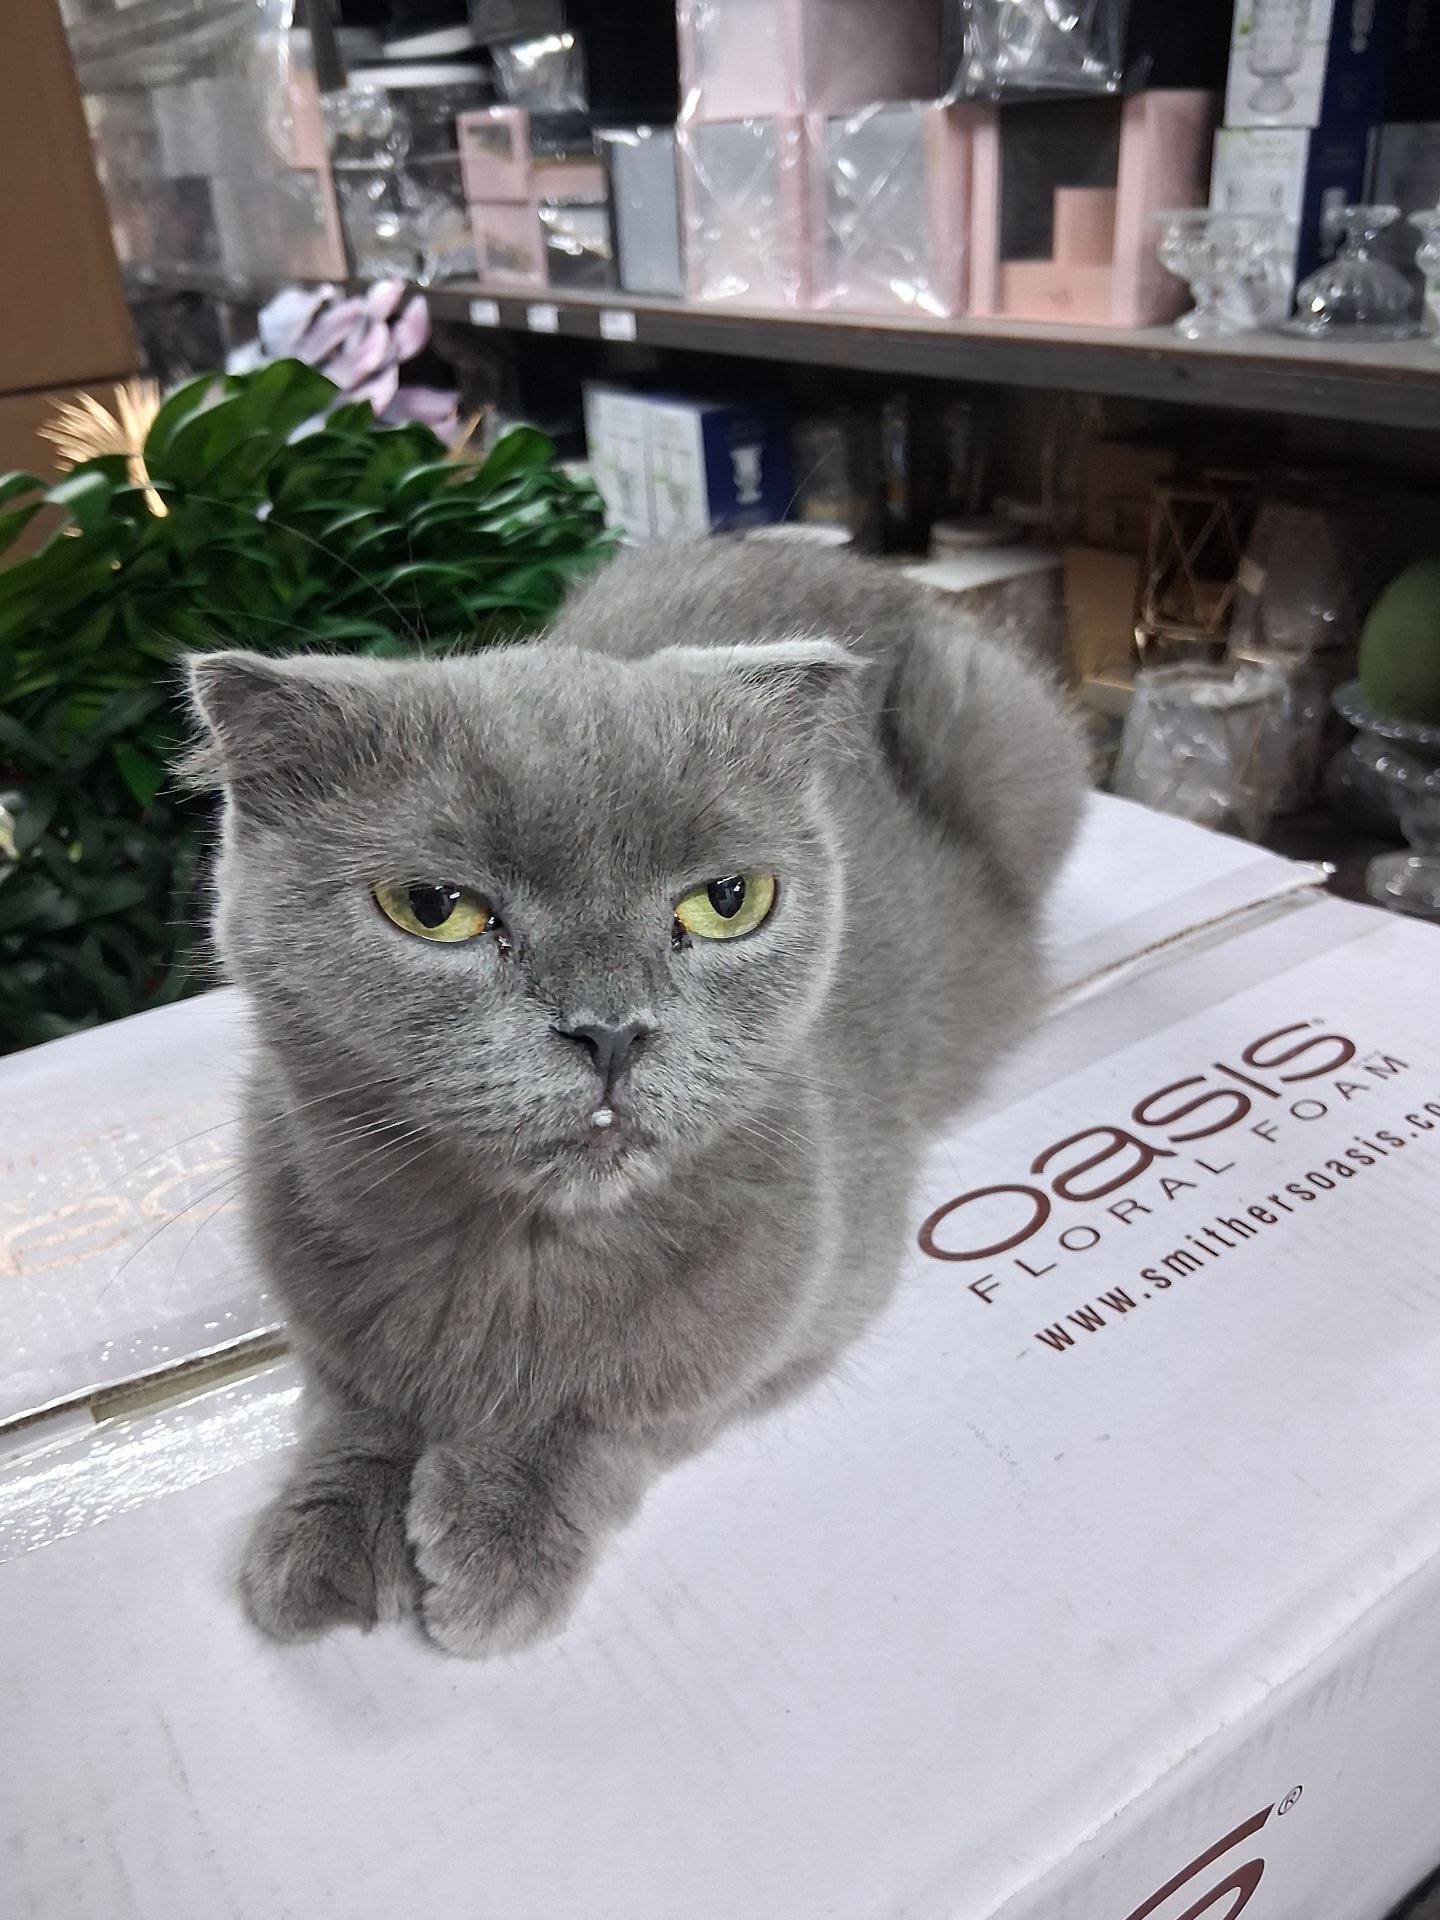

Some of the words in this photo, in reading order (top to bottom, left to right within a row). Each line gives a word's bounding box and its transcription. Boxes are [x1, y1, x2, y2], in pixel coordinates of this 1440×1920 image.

[967, 1158, 1235, 1305] FLORAL
[1250, 1055, 1410, 1144] FOAM
[1034, 1102, 1440, 1352] www.smithersoasis.co
